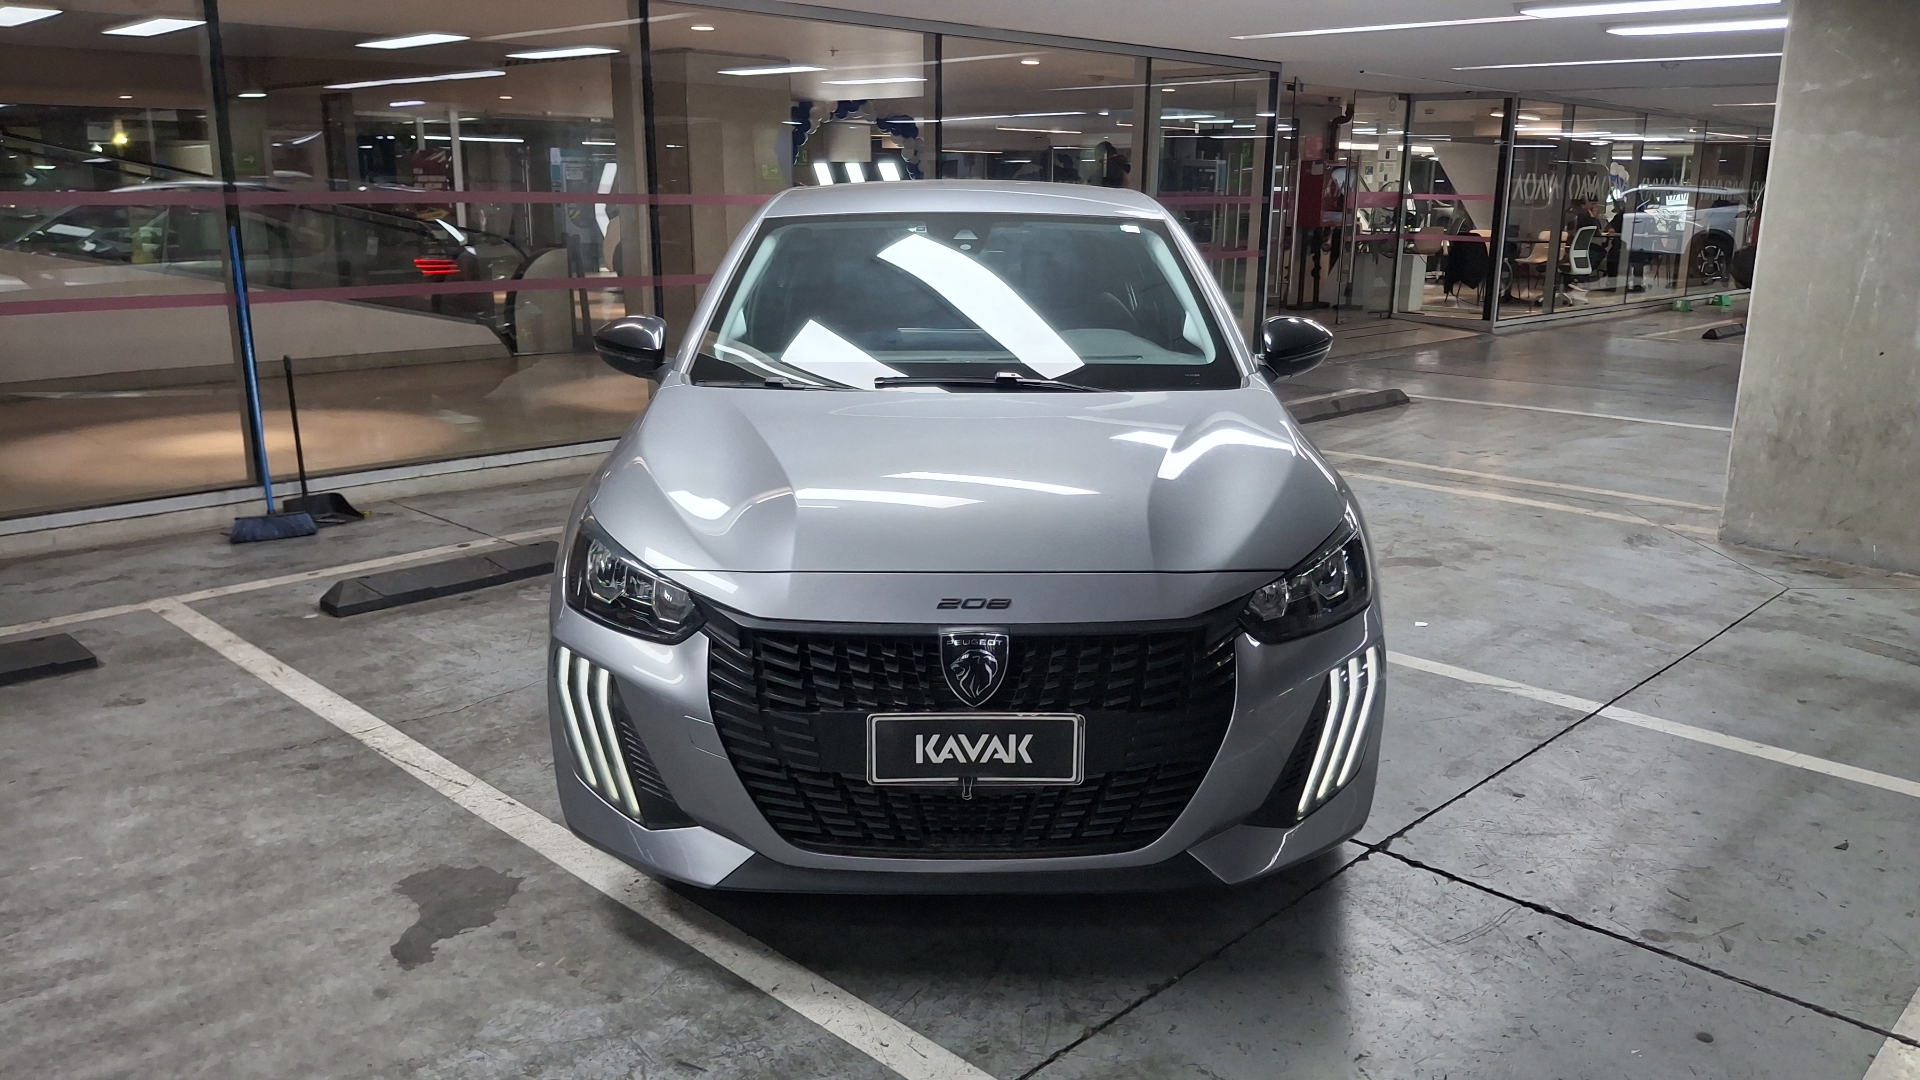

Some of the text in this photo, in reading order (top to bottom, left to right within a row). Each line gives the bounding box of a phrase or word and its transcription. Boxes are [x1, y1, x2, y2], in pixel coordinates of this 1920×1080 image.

[936, 598, 1012, 610] 208
[946, 638, 1003, 646] PEUGEOT
[915, 733, 1034, 764] KAVAK
